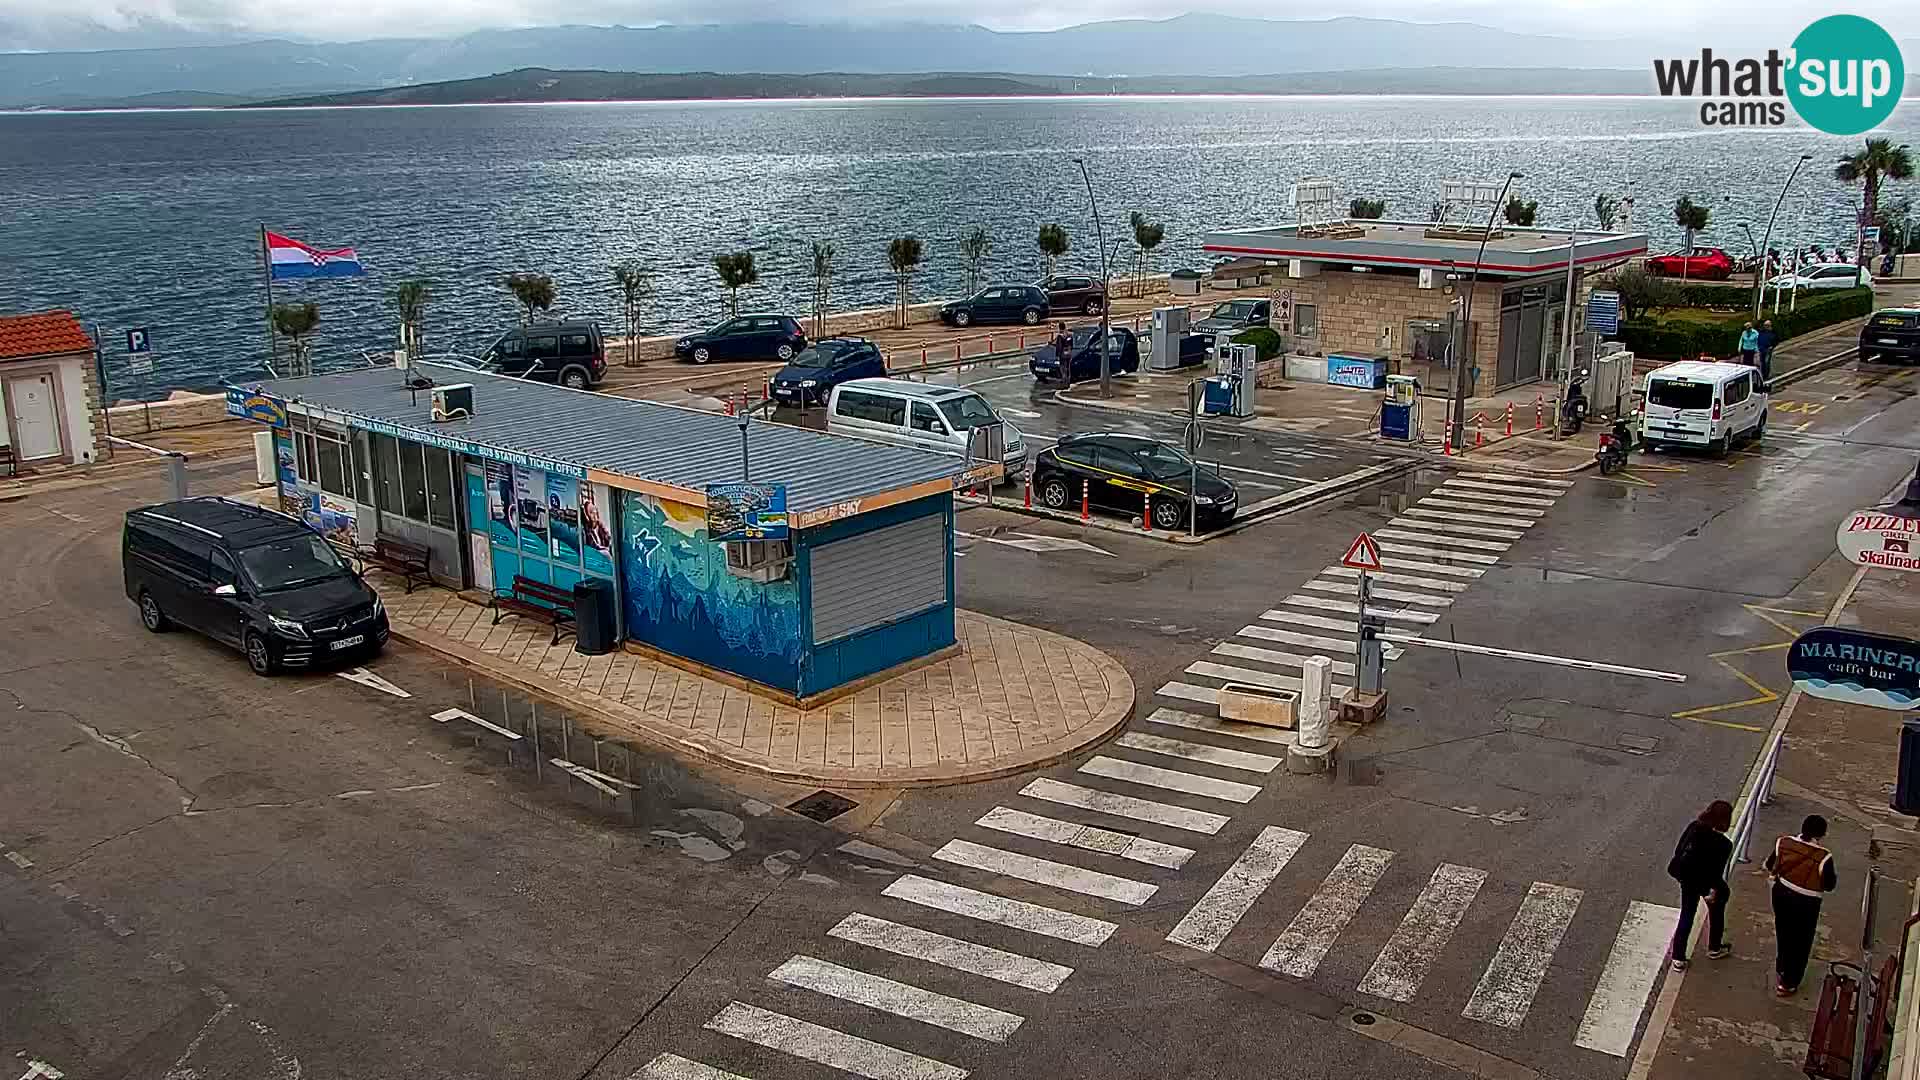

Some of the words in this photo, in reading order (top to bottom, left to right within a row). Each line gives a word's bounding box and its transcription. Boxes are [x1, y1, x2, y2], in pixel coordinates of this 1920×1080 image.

[131, 331, 144, 350] P
[437, 437, 469, 453] POSTAJA
[479, 446, 494, 458] BUS
[494, 449, 527, 465] STATION
[529, 456, 555, 471] TICKET
[555, 462, 583, 477] OFFICE
[1847, 515, 1920, 533] PIZZE
[1880, 530, 1918, 541] GRILL
[1828, 662, 1865, 676] caffe
[1869, 665, 1897, 681] bar
